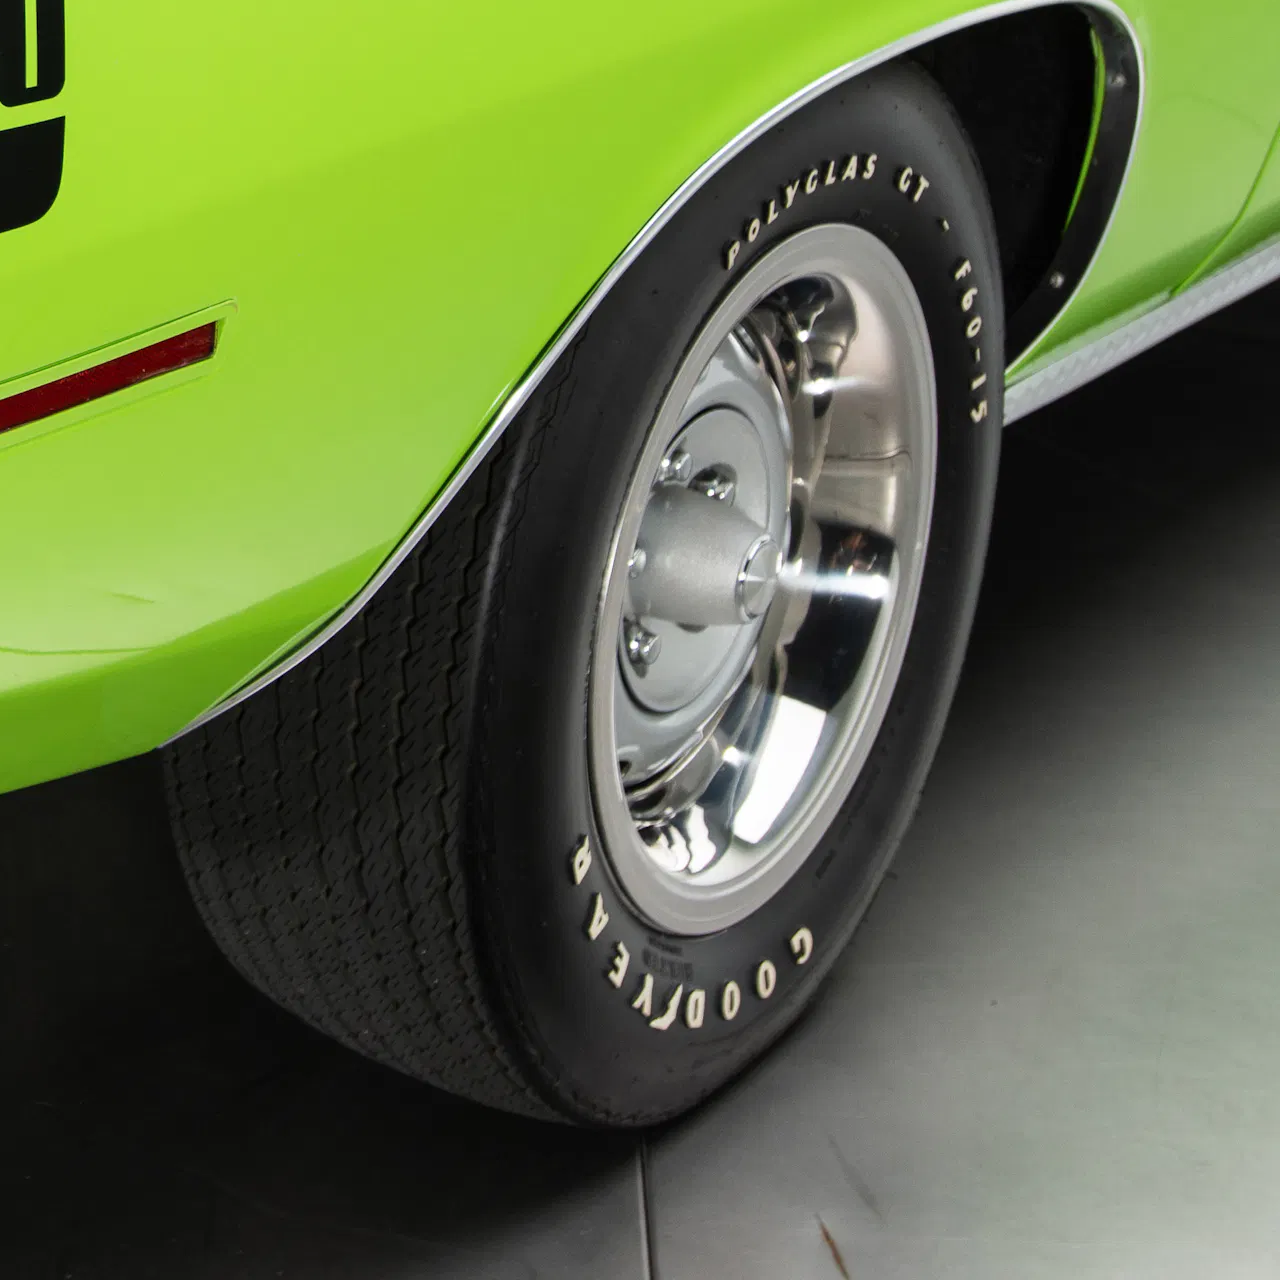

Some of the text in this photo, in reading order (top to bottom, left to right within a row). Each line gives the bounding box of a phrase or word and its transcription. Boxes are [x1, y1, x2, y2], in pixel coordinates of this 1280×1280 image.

[724, 153, 878, 271] POLYGLAS
[897, 166, 930, 203] GT
[572, 834, 814, 1032] GOODYEAR
